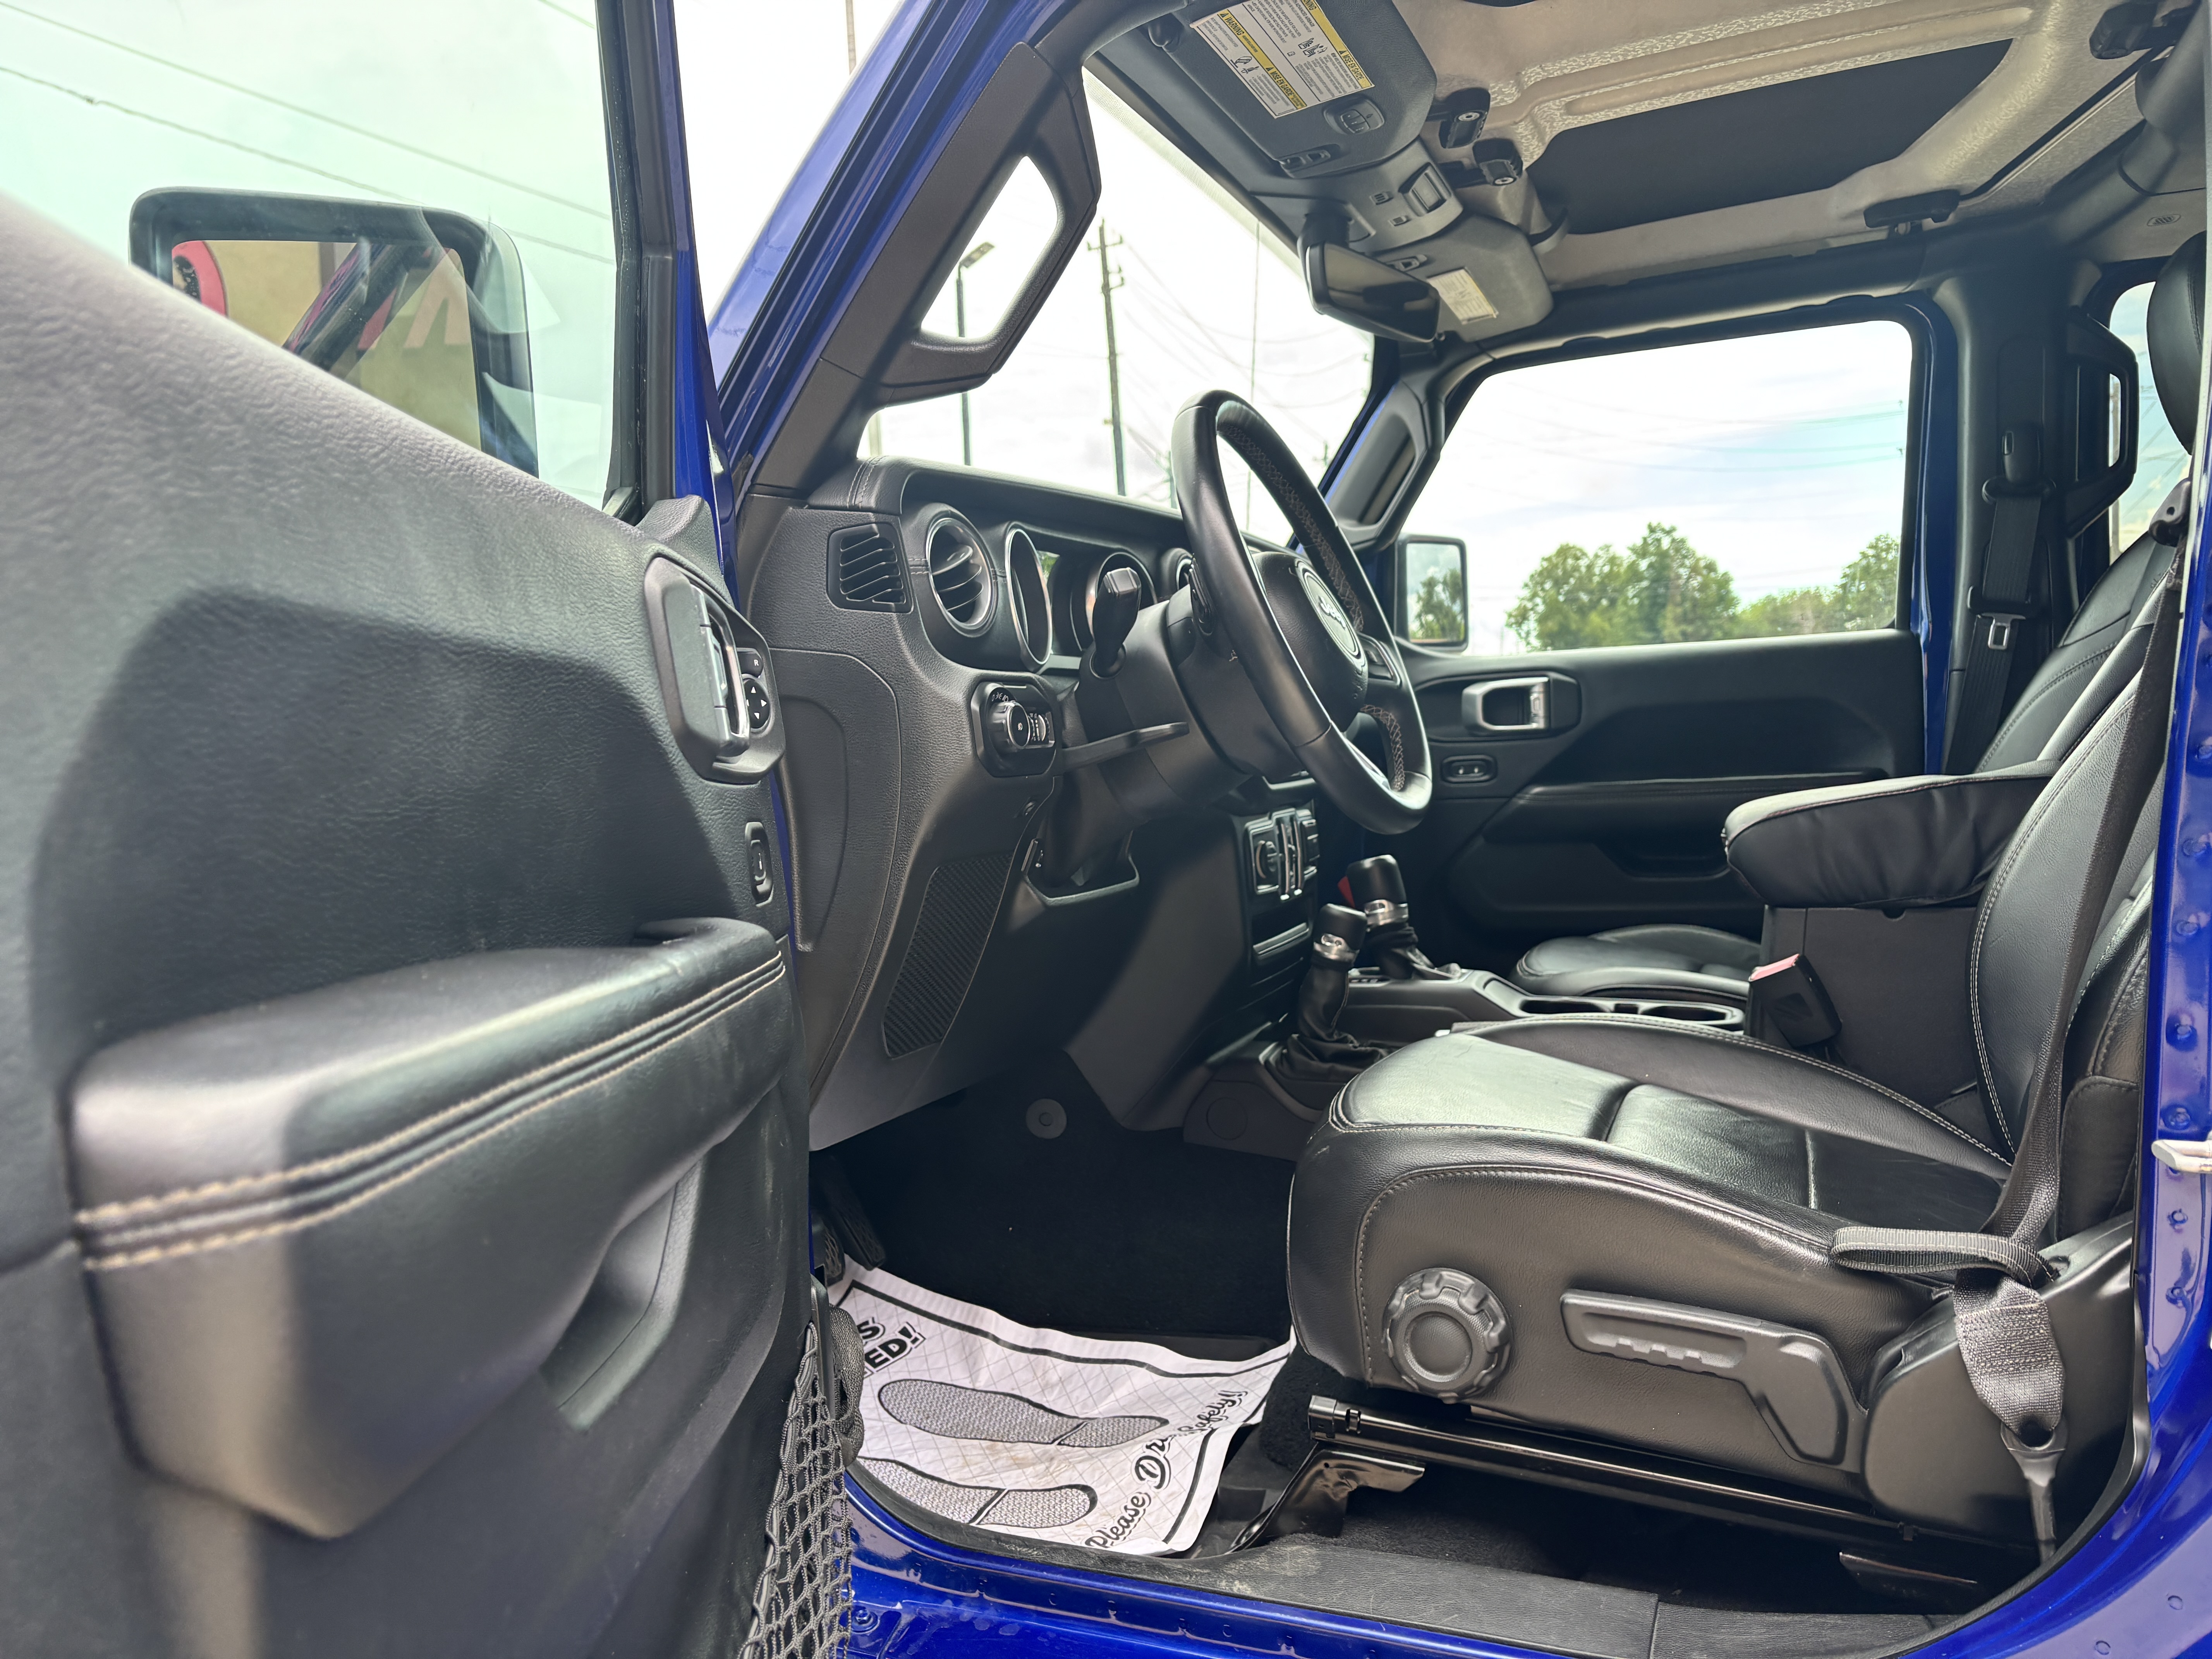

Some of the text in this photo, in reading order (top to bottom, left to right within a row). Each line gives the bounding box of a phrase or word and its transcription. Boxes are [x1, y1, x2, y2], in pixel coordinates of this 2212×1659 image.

[1224, 17, 1245, 36] WARNING
[1319, 596, 1346, 629] Jeep
[864, 1324, 923, 1371] ED!
[1085, 1493, 1149, 1548] Please
